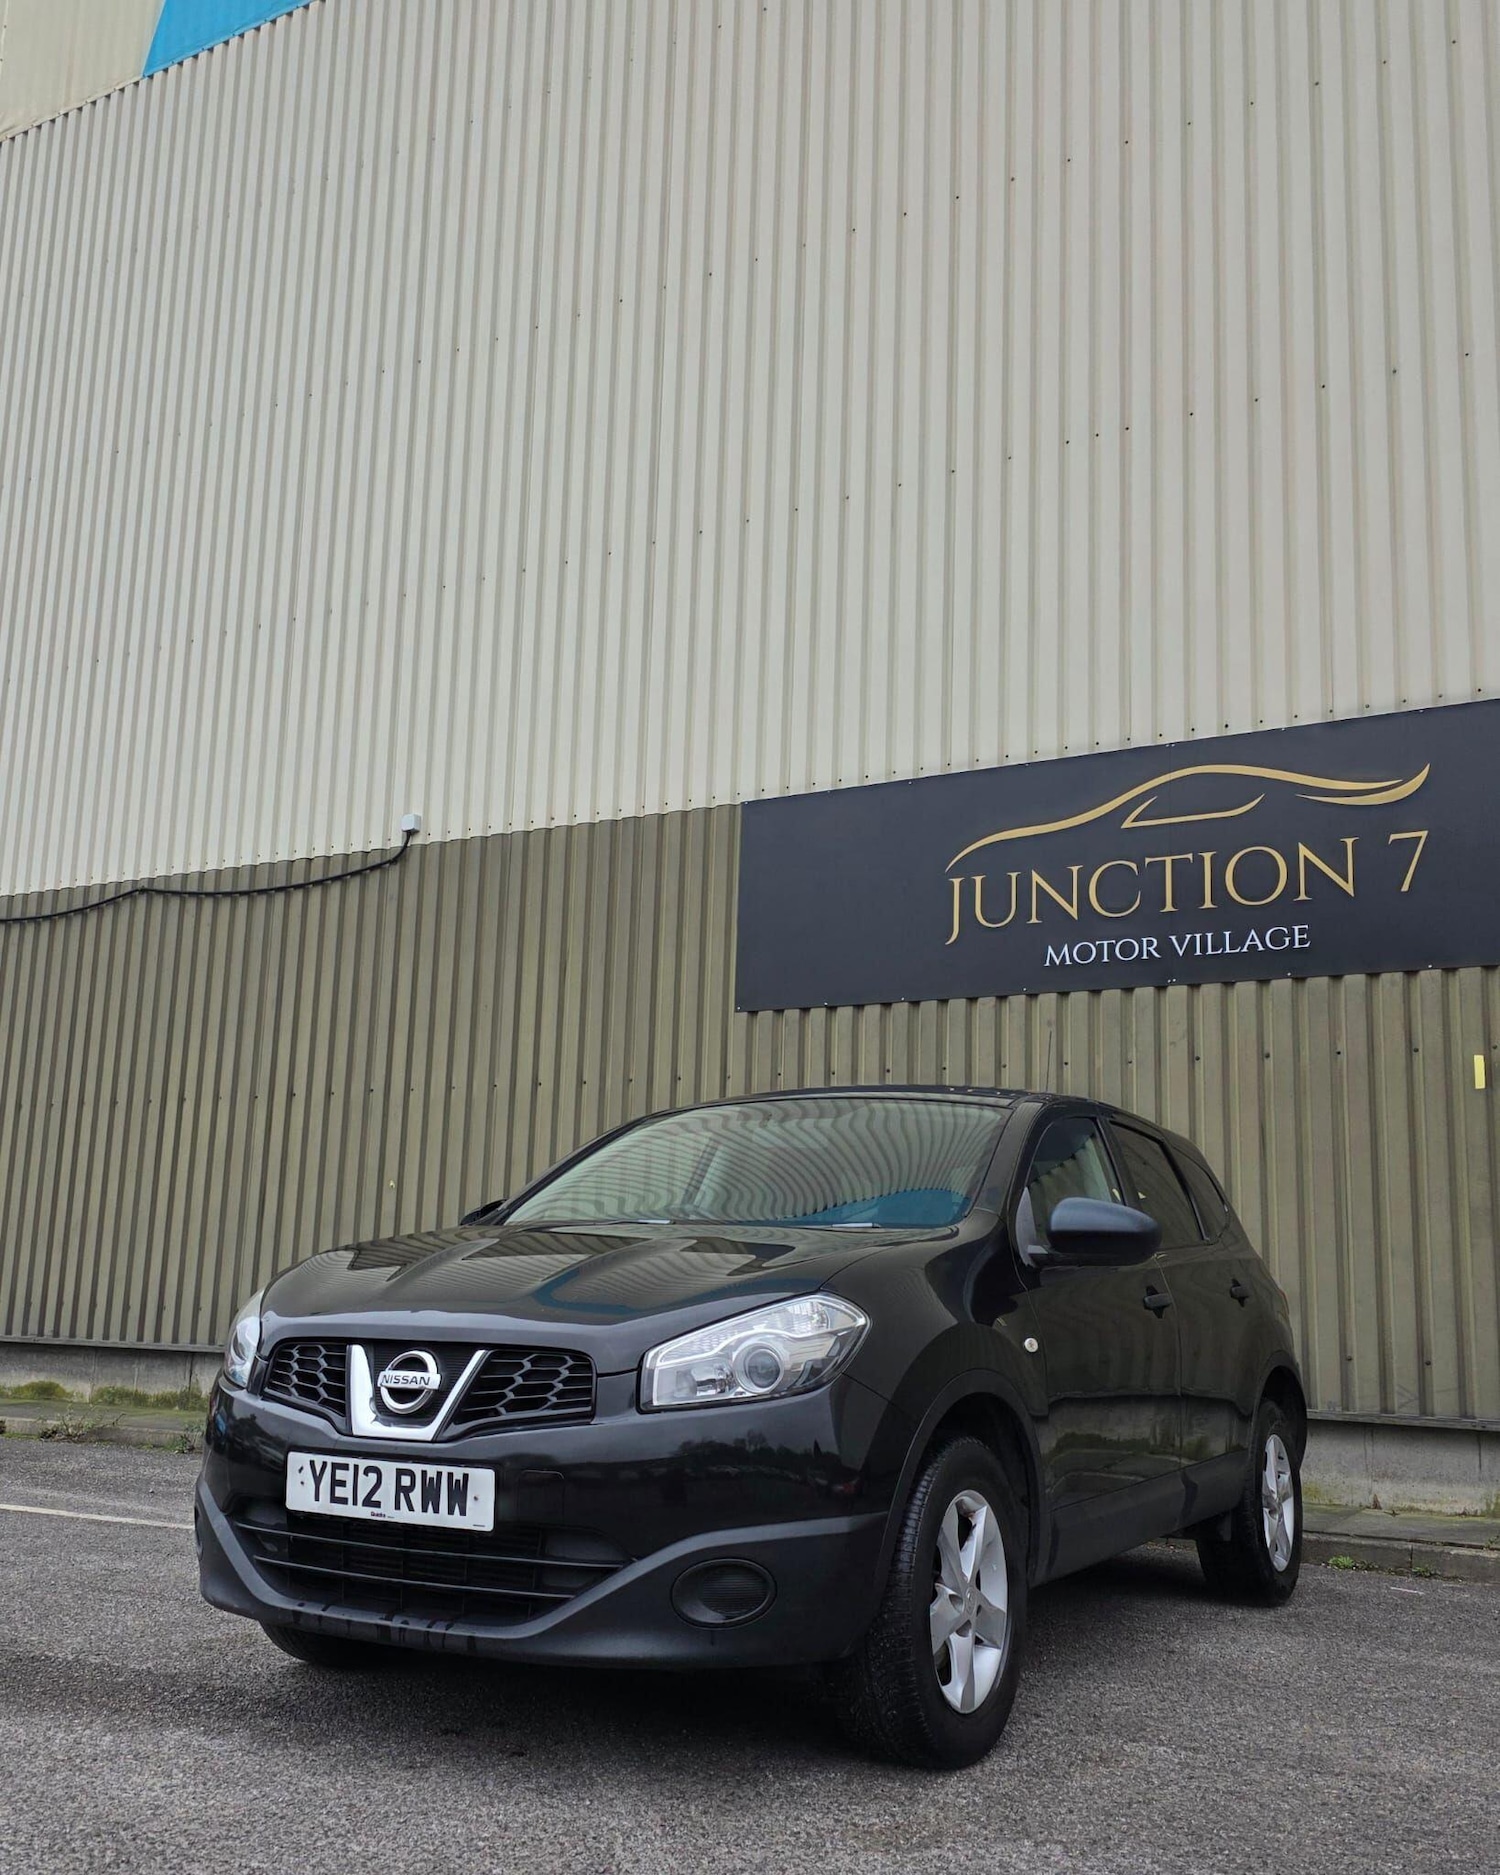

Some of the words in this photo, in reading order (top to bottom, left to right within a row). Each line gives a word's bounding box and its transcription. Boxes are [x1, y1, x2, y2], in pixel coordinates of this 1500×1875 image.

[945, 836, 1360, 945] JUNCTION
[1387, 829, 1429, 893] 7
[1043, 936, 1162, 967] MOTOR
[1169, 923, 1311, 957] VILLAGE
[381, 1374, 431, 1386] NISSAN
[309, 1459, 383, 1509] YE12
[394, 1467, 470, 1517] RWW
